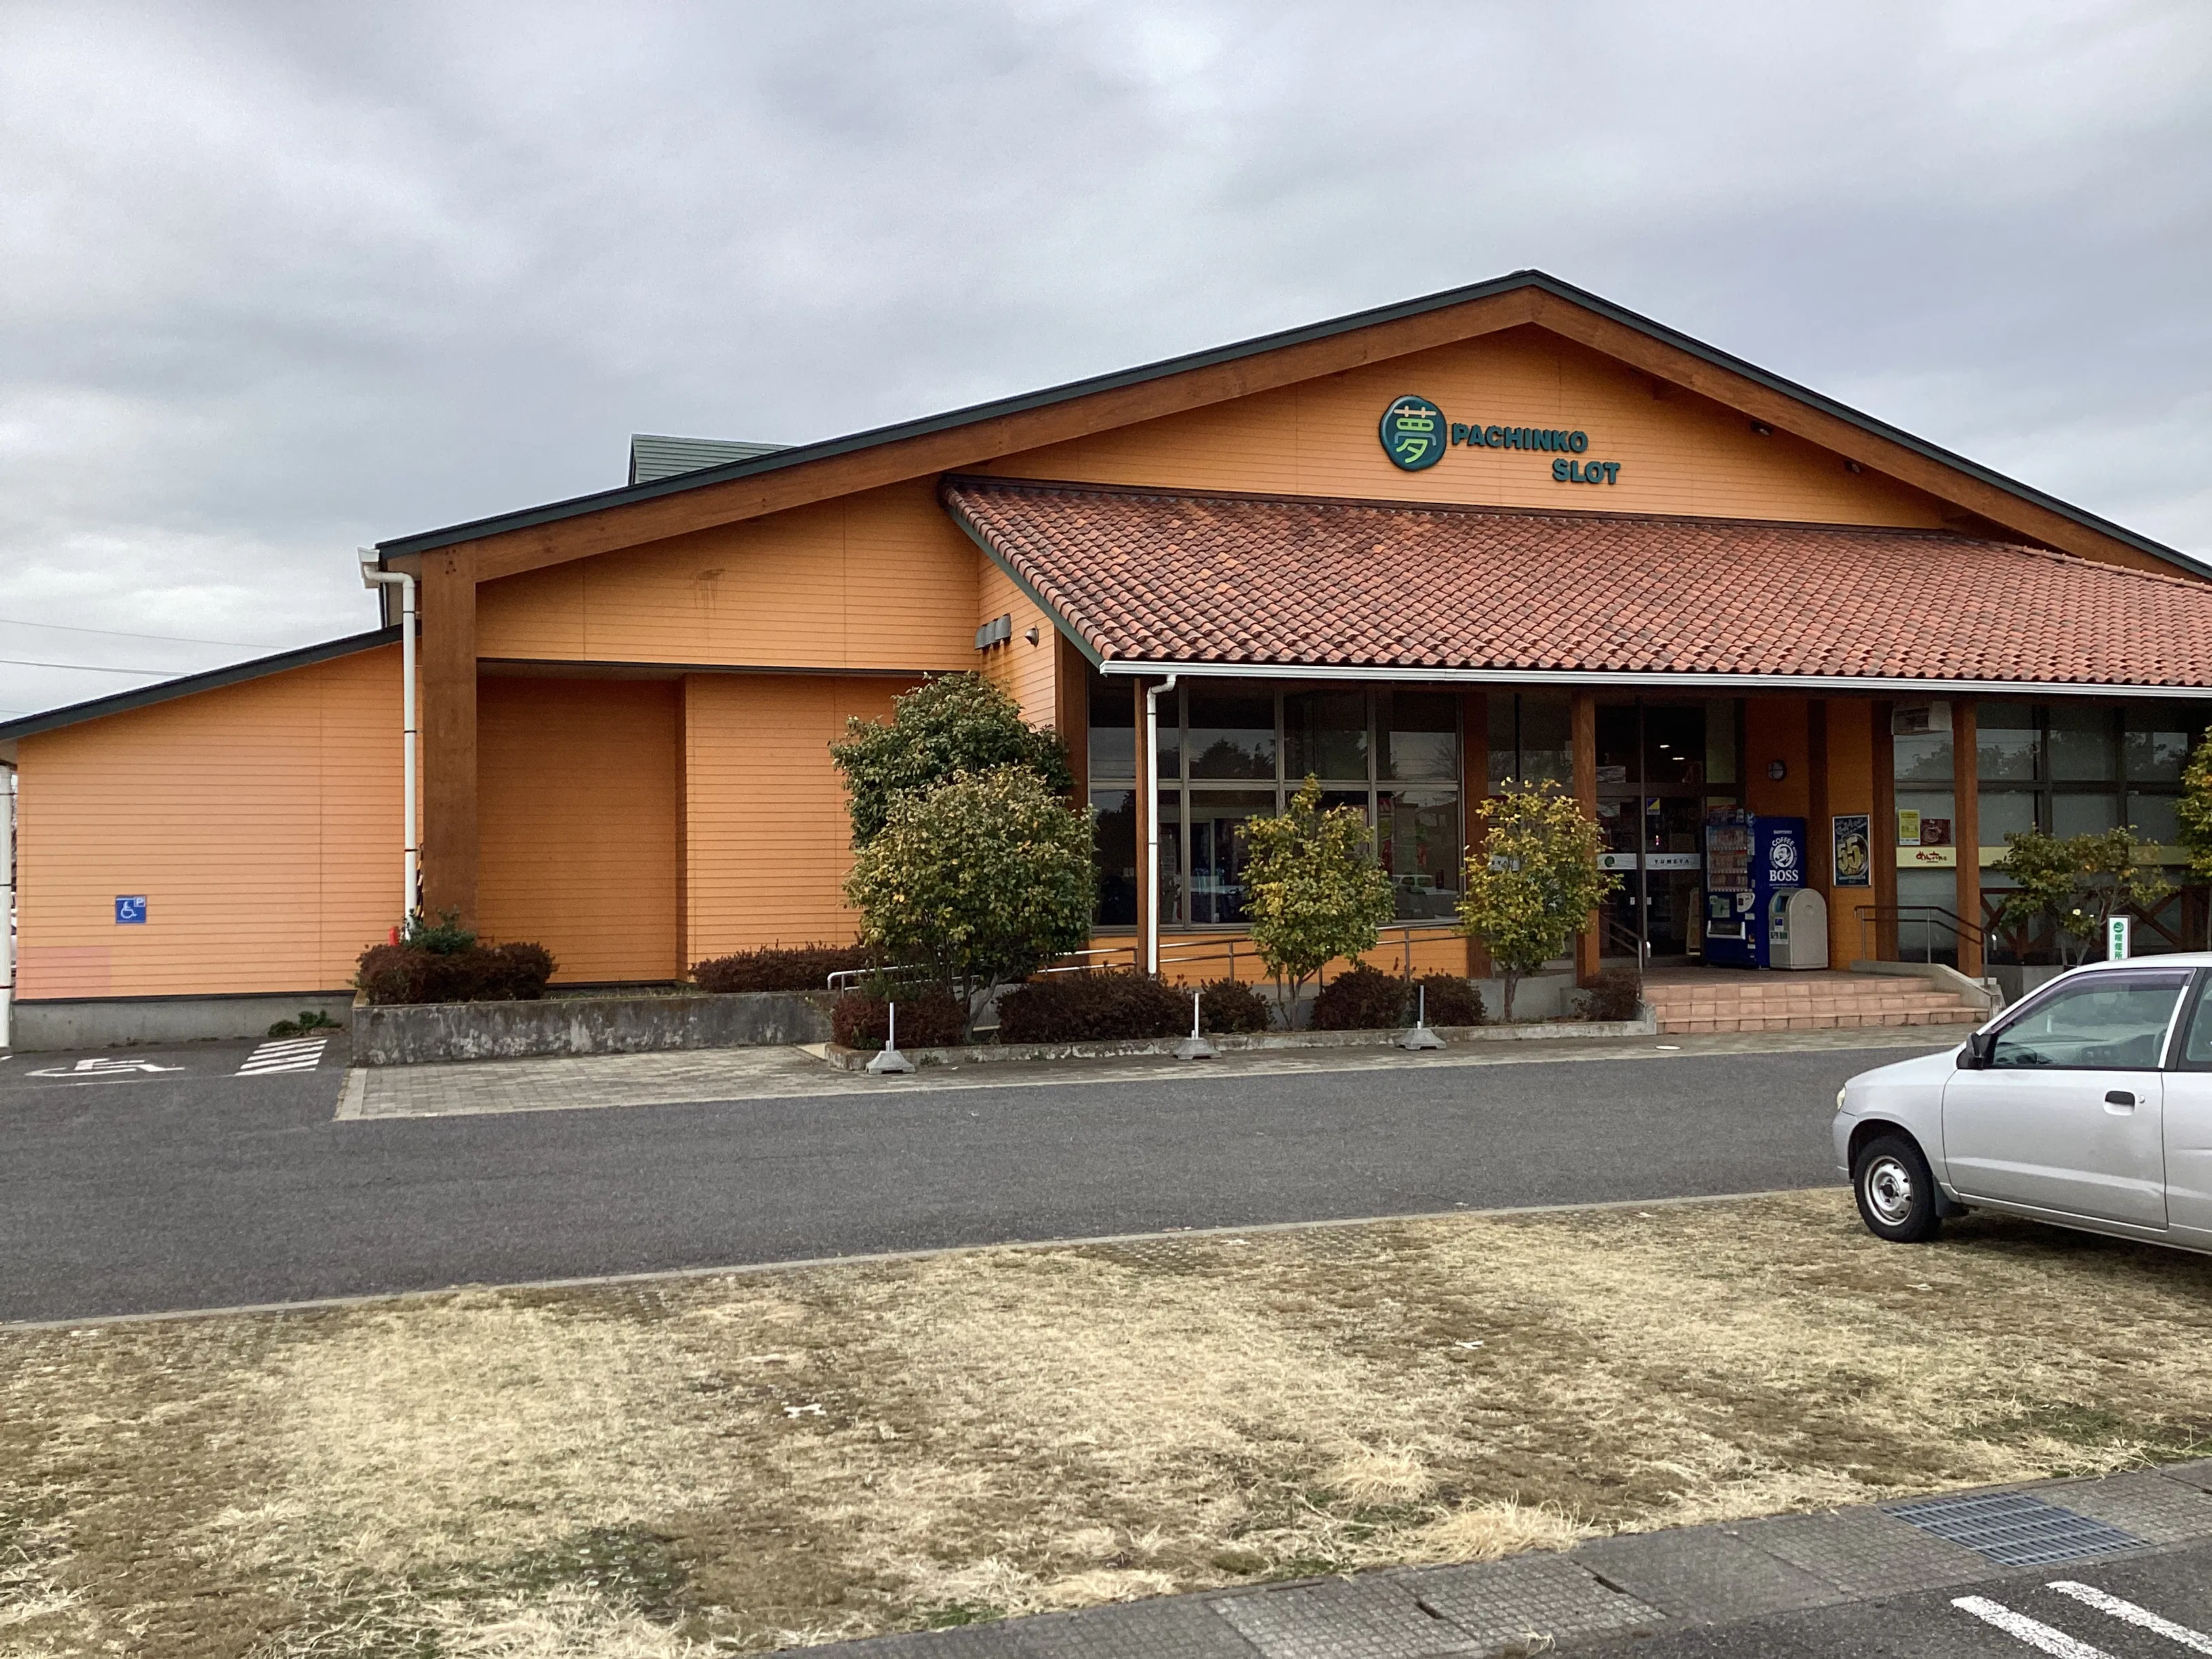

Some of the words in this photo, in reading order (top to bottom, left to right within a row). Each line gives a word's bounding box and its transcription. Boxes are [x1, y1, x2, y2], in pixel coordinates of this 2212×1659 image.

[1393, 405, 1437, 464] 夢
[1452, 422, 1589, 453] PACHINKO
[1552, 458, 1621, 485] SLOT
[1771, 836, 1795, 846] COFFEE
[1769, 869, 1799, 882] BOSS
